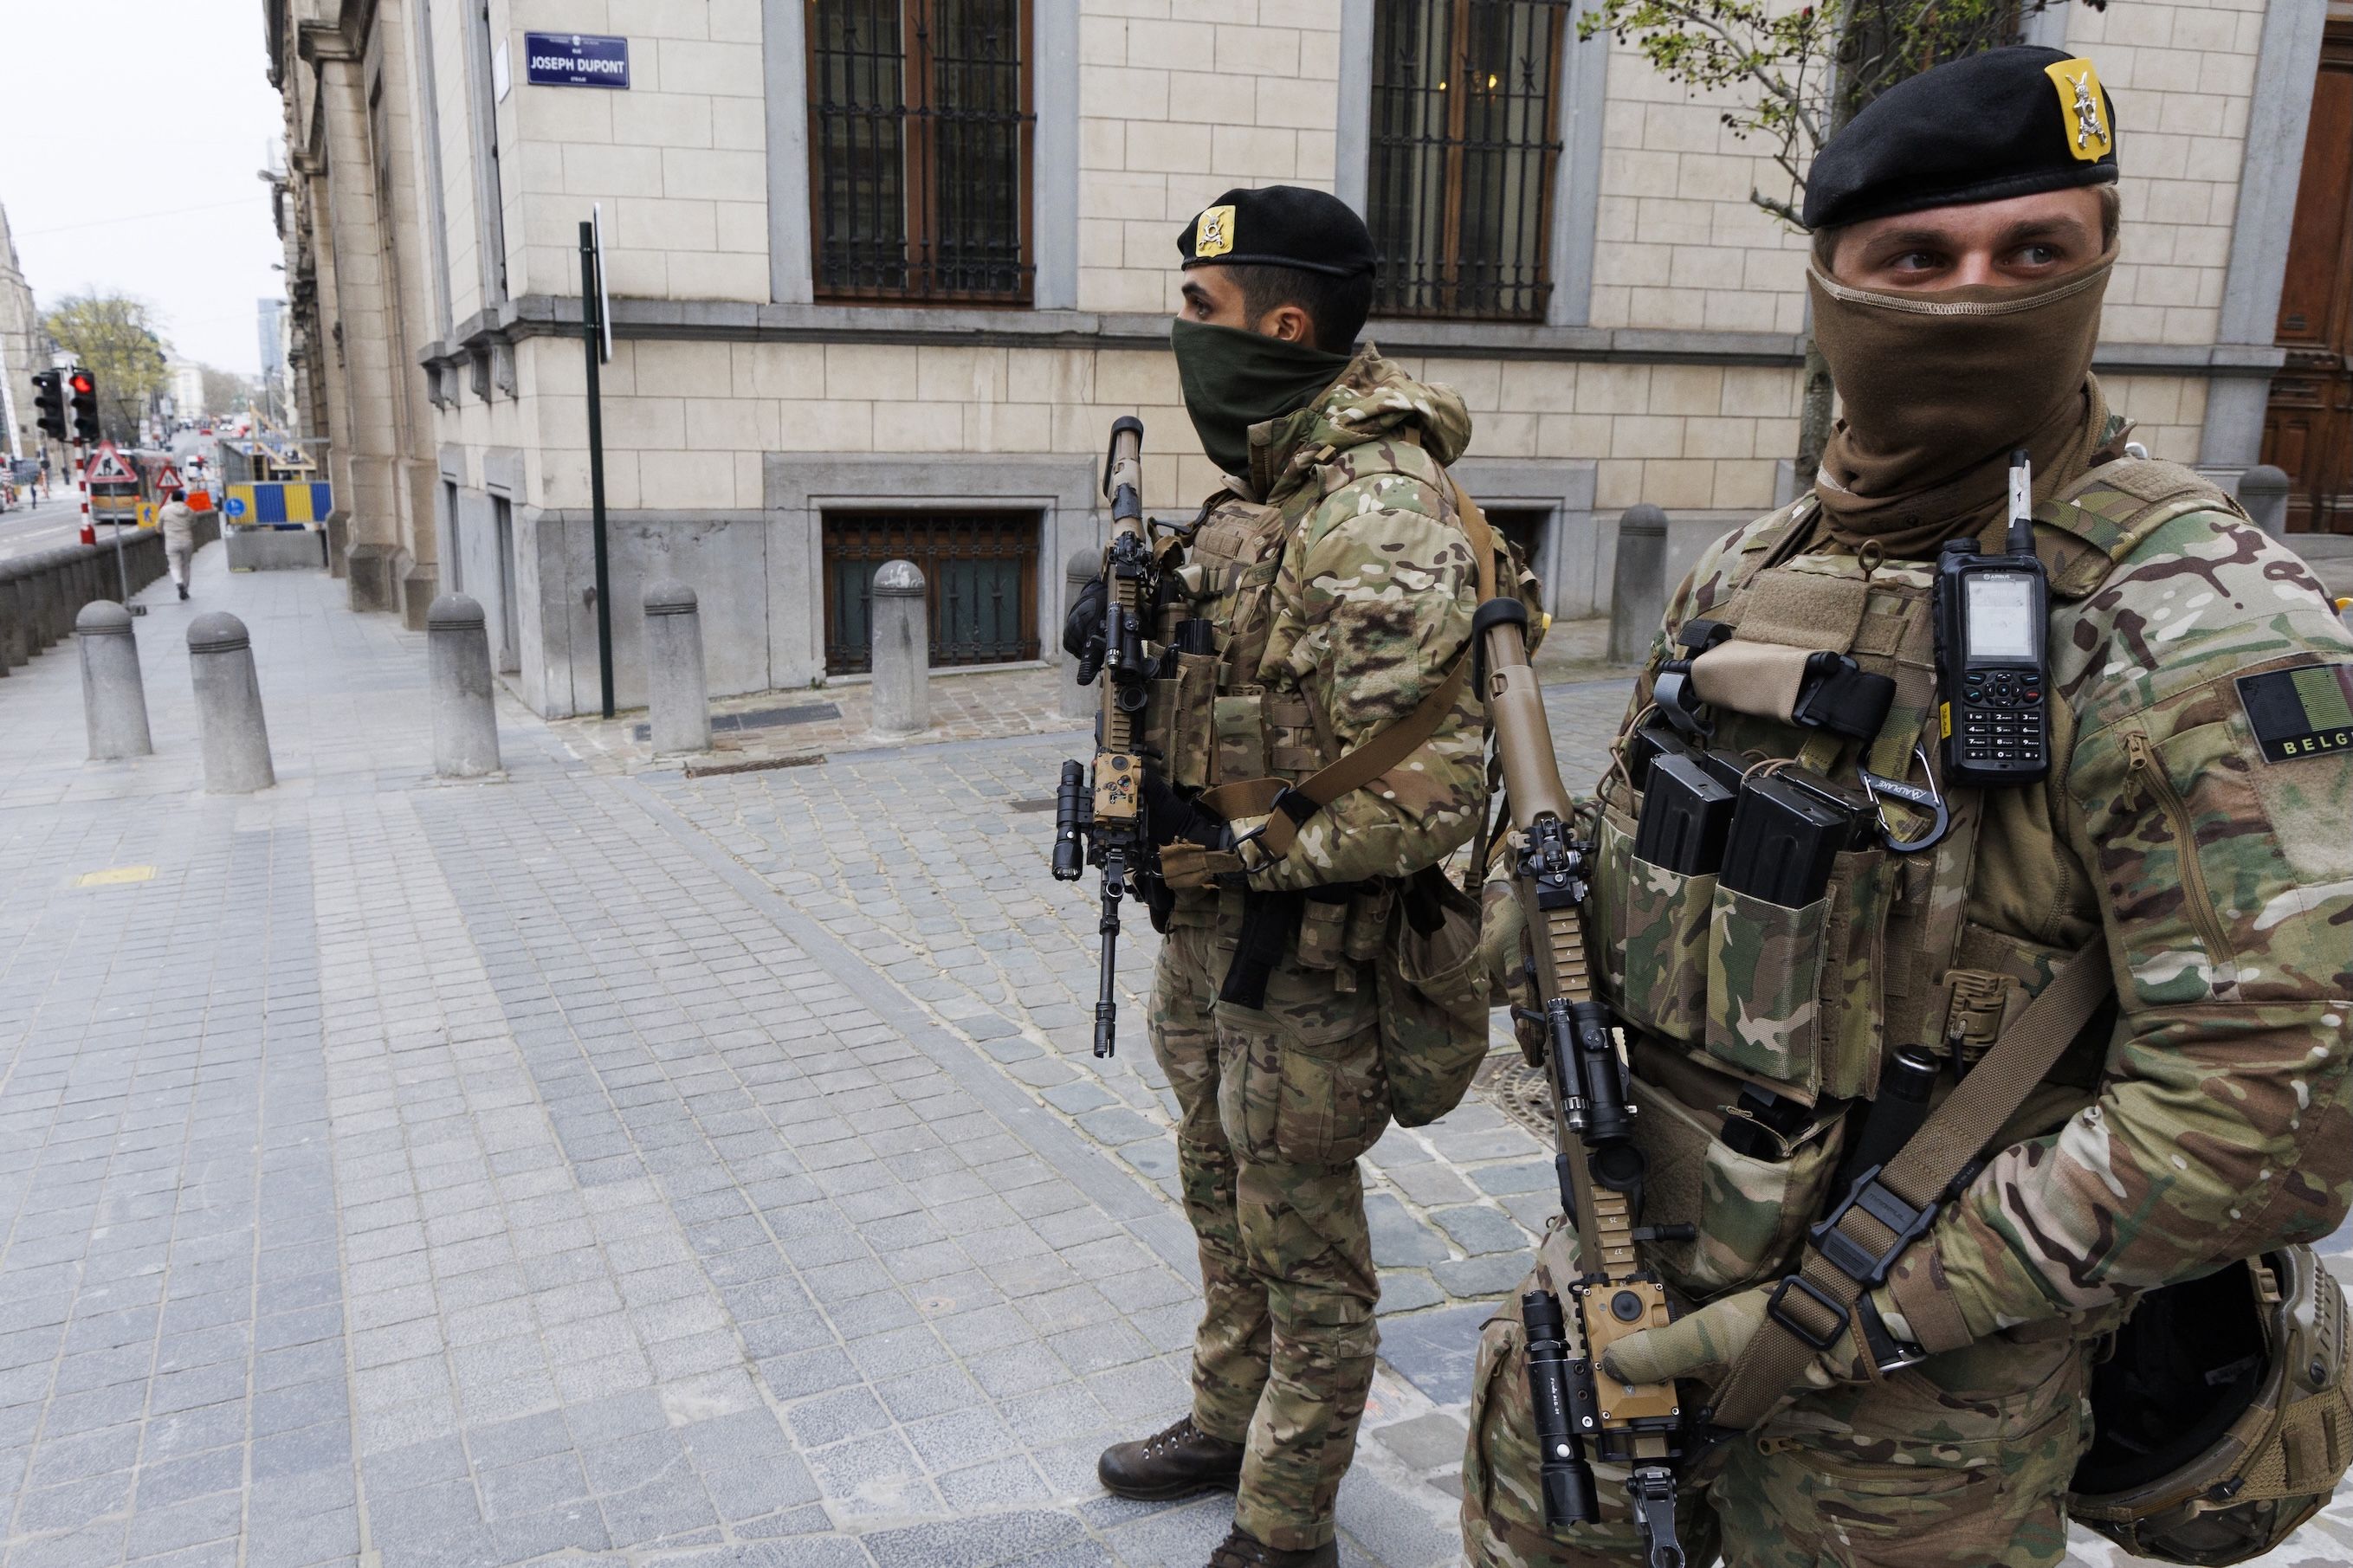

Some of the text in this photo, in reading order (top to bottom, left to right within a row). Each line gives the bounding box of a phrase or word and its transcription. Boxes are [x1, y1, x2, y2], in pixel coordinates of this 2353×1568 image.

[530, 55, 624, 74] JOSEPH DUPONT
[2283, 732, 2353, 755] BELG
